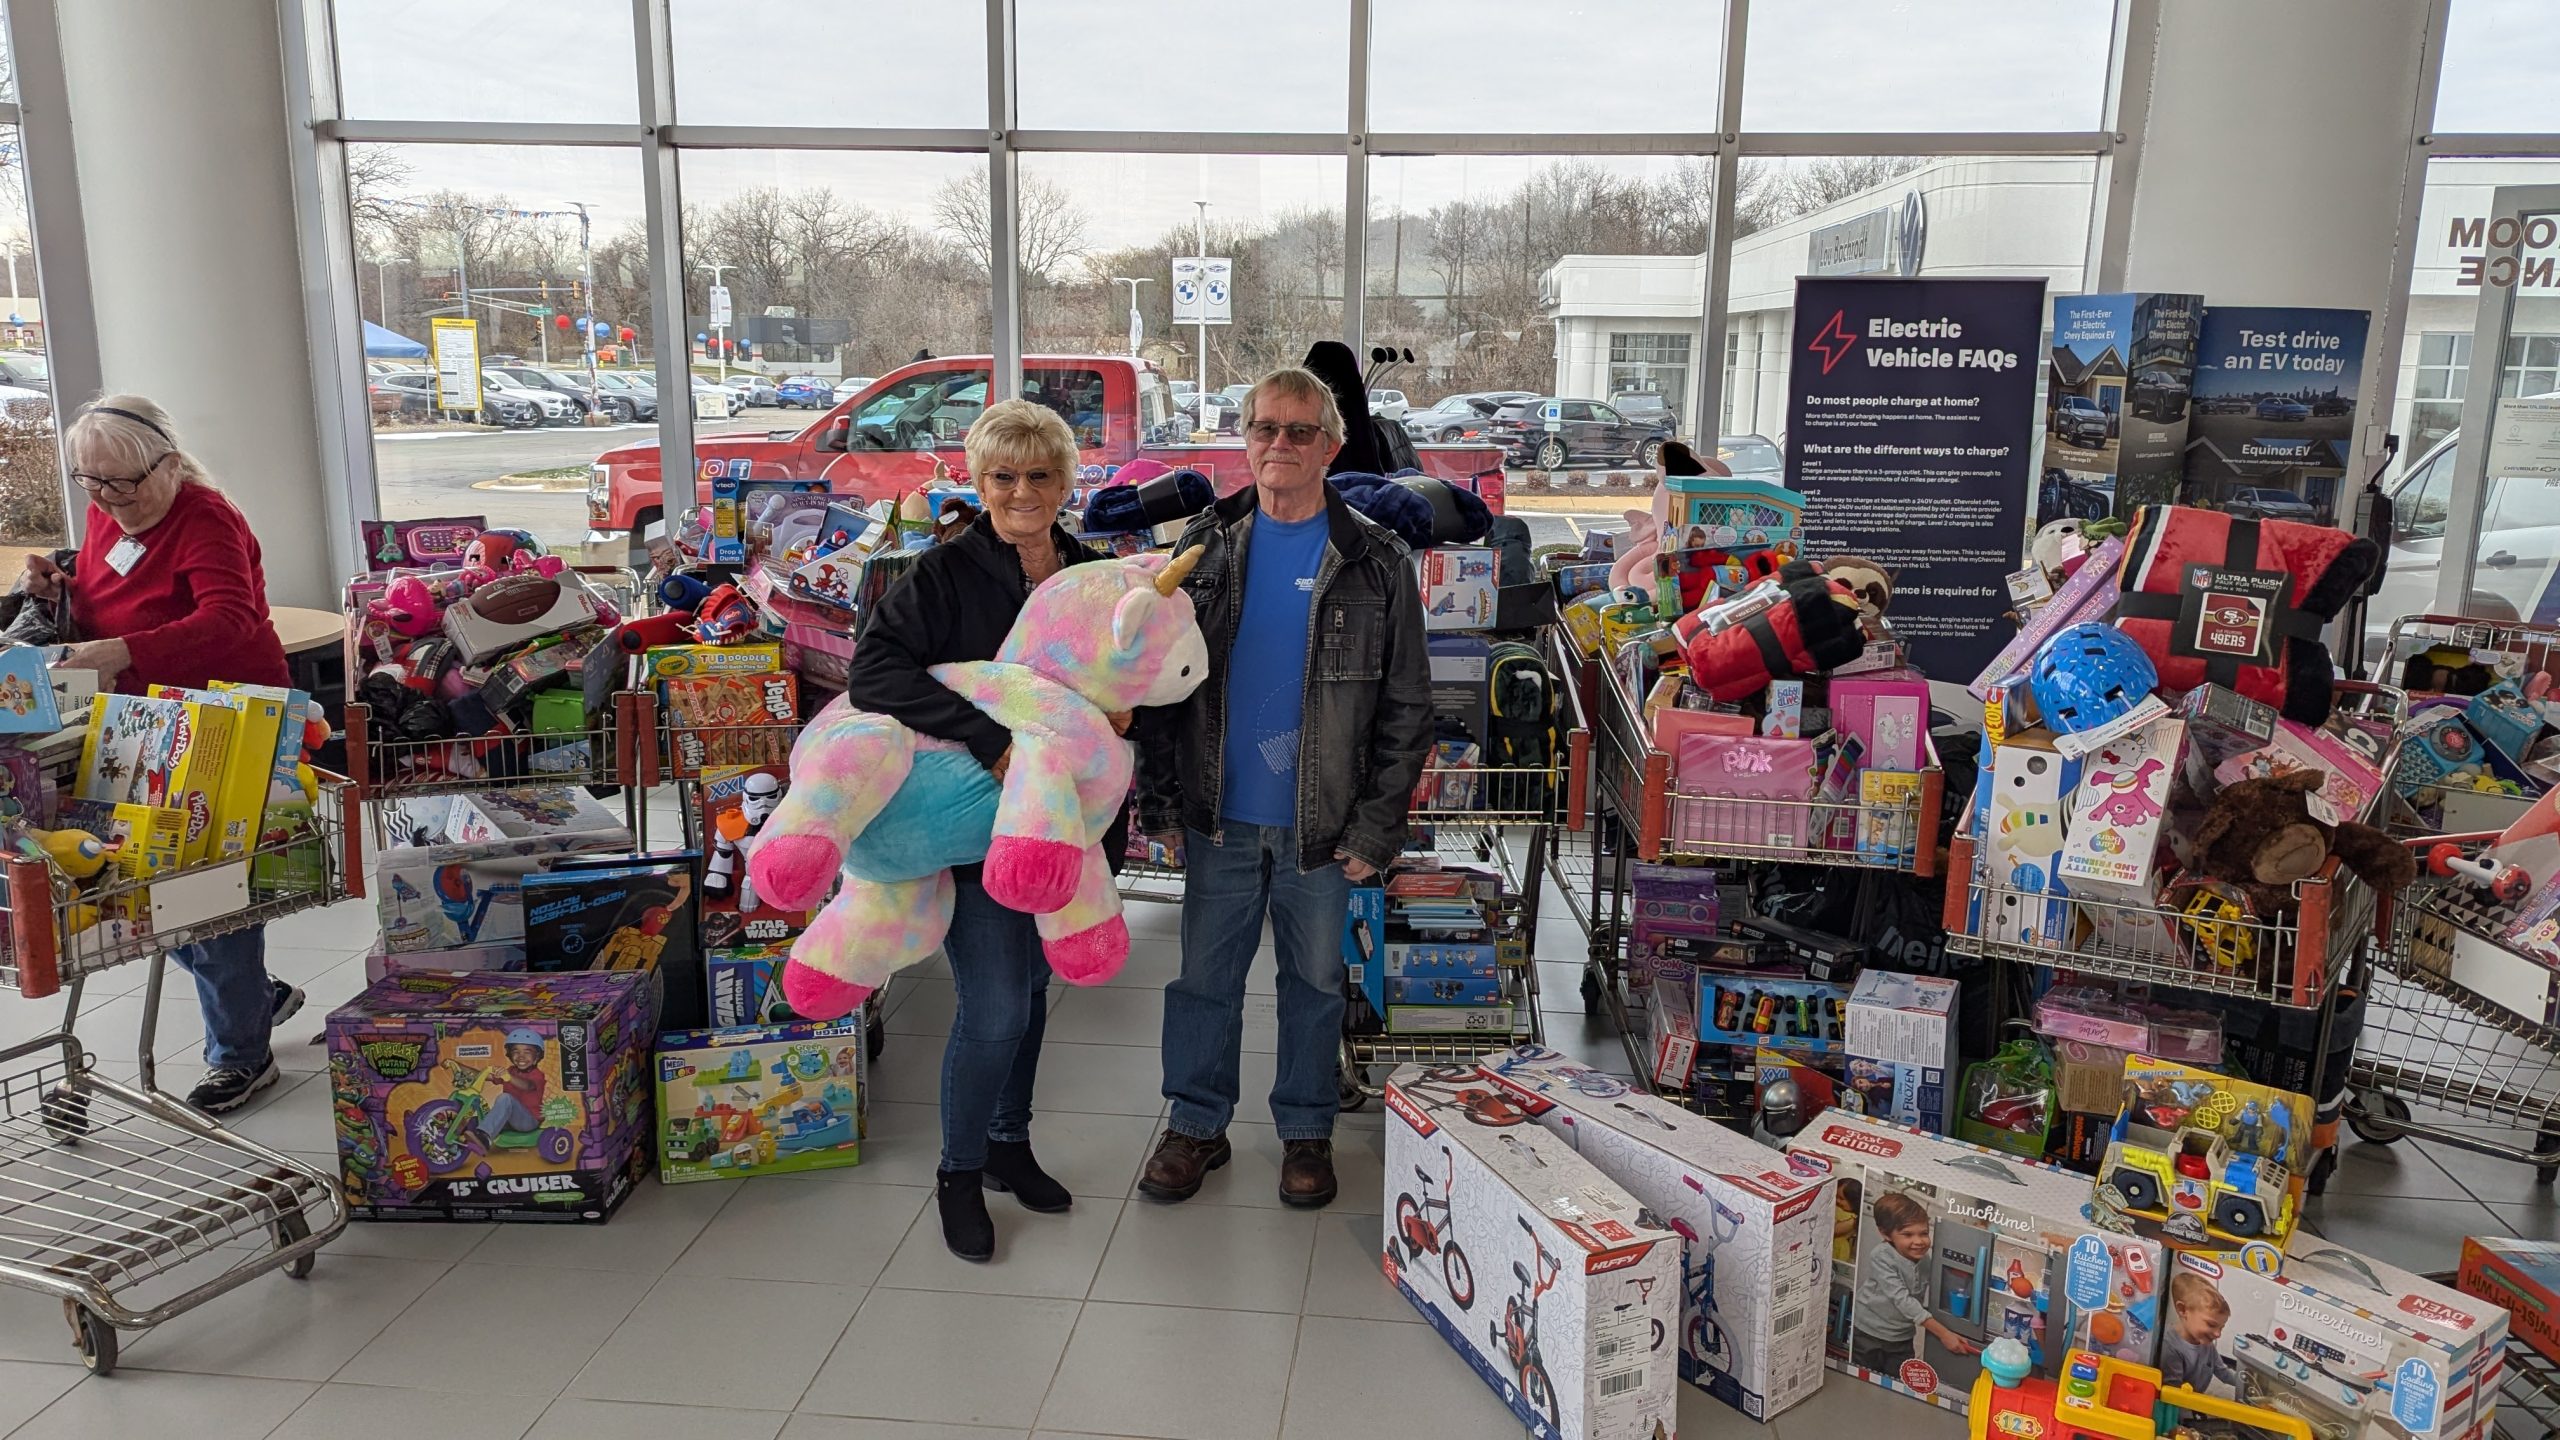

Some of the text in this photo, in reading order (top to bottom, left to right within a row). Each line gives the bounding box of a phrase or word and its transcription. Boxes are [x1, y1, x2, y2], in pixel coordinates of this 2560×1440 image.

[1833, 224, 1869, 266] Bachrodt
[2070, 310, 2112, 319] The First-Ever
[2154, 309, 2191, 319] The First-Ever
[1868, 317, 1962, 339] Electric
[2072, 319, 2107, 329] All-Electric
[2156, 320, 2186, 330] All-Electric
[2064, 330, 2116, 341] Chevy Equinox EV
[2149, 331, 2190, 341] Chevy Blazer EV
[2239, 330, 2340, 350] Test drive
[1866, 347, 2018, 373] Vehicle FAQs
[2224, 352, 2345, 375] an EV today
[1806, 395, 1980, 408] Do most people charge at home?
[1882, 414, 1907, 422] happens
[1803, 444, 2010, 458] What are the different ways to charge?
[2242, 444, 2310, 458] Equinox EV
[715, 481, 737, 490] vtech
[719, 548, 738, 558] Drop
[719, 555, 740, 563] Dump
[1421, 555, 1430, 598] HUFFY
[2216, 573, 2283, 587] ULTRA PLUSH
[1922, 585, 1998, 597] is required for
[2252, 583, 2277, 591] THROW
[2029, 616, 2056, 644] DESIGN
[2051, 588, 2082, 620] STATION
[2210, 632, 2247, 648] 49ERS
[700, 654, 773, 663] TUB DOODLES
[764, 679, 794, 721] Jenga
[1777, 686, 1799, 699] baby
[2119, 703, 2163, 728] Toddler
[168, 710, 190, 769] Play-Doh
[1722, 747, 1773, 774] pink
[186, 794, 206, 844] Play-Doh
[1980, 807, 1990, 832] HOT
[2065, 862, 2137, 881] HELLO KITTY
[2067, 855, 2138, 872] AND FRIENDS
[529, 894, 582, 917] ACTION
[745, 919, 788, 930] STAR
[745, 928, 788, 939] WARS
[715, 966, 737, 1028] GIANT
[735, 978, 745, 1017] EDITION
[791, 1017, 854, 1033] BLOKS
[814, 1027, 853, 1037] MEGA
[2078, 1026, 2111, 1042] Barbie
[1669, 1041, 1680, 1063] BATTING
[665, 1059, 685, 1070] MEGA
[665, 1066, 696, 1081] BLOKS
[2127, 1069, 2184, 1079] imaginext
[1903, 1068, 1916, 1112] FROZEN
[1389, 1093, 1427, 1129] HUFFY
[1827, 1133, 1895, 1158] FRIDGE
[1846, 1129, 1886, 1146] First
[2072, 1115, 2084, 1160] mongoose
[1792, 1153, 1828, 1170] little tikes
[486, 1174, 581, 1195] CRUISER
[1776, 1198, 1810, 1220] HUFFY
[1946, 1198, 2036, 1233] Lunchtime!
[2185, 1230, 2209, 1243] WORLD
[2084, 1239, 2100, 1254] 10
[1591, 1252, 1637, 1271] HUFFY
[2074, 1251, 2109, 1267] Kitchen
[2181, 1254, 2219, 1275] little tikes
[1399, 1280, 1440, 1329] PRO THUNDER
[2412, 1298, 2466, 1322] OVEN
[2280, 1292, 2384, 1350] Dinnertime!
[2412, 1362, 2425, 1378] 10
[2400, 1371, 2435, 1392] Cooking
